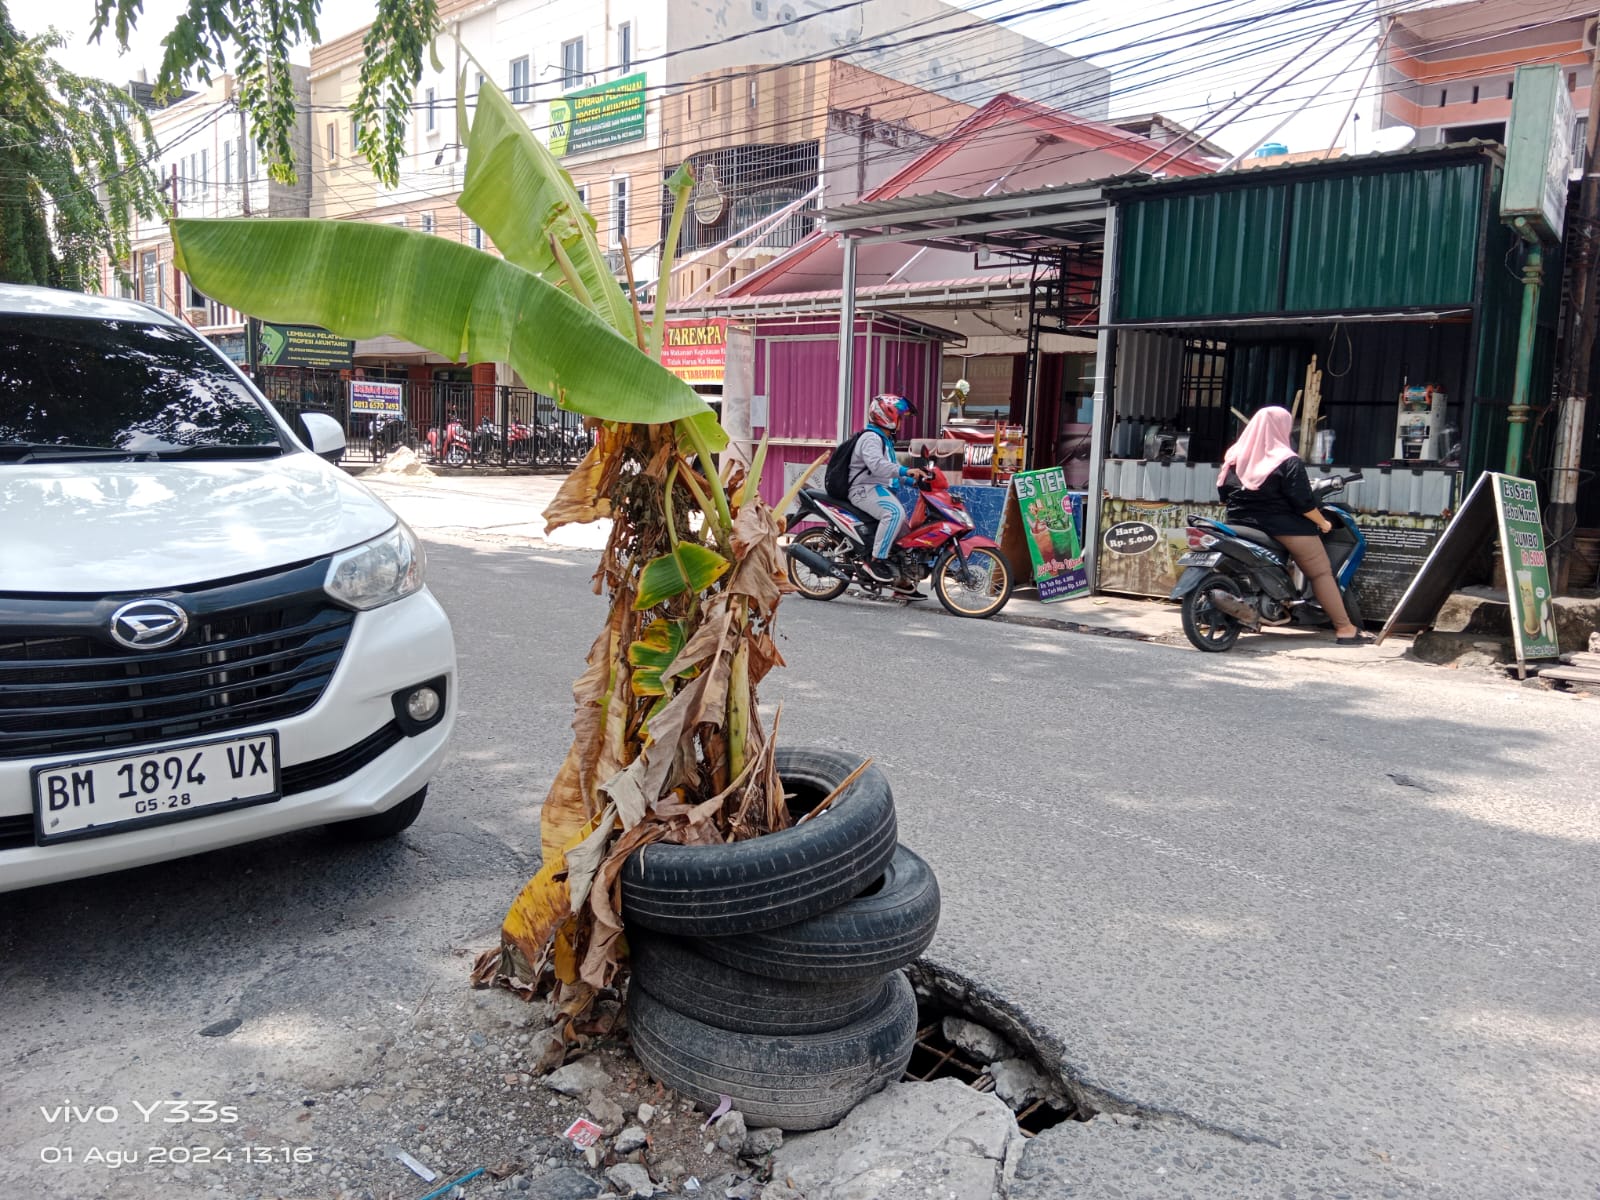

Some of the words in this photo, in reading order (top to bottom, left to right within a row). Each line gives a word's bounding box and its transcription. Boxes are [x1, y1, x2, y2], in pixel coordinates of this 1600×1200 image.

[575, 95, 605, 109] LEMBAGA
[605, 81, 642, 100] PELATIHAN
[575, 107, 601, 125] PROFESI
[601, 97, 641, 117] AKUNTANSI
[286, 330, 317, 338] LEMBAGA
[289, 337, 314, 345] PROFESI
[314, 339, 348, 347] AKUNTANSI
[667, 325, 722, 346] TAREMPA
[353, 401, 369, 409] 0813
[1014, 477, 1036, 499] ES
[1036, 470, 1067, 495] TEH
[1503, 480, 1515, 498] Es
[1514, 483, 1534, 502] Sari
[1503, 502, 1519, 519] Tebu
[1518, 505, 1540, 523] Murni
[1115, 526, 1145, 536] Harga
[1514, 531, 1539, 549] JUMBO
[1109, 539, 1126, 548] Rp.
[1128, 535, 1154, 545] 5.000
[1529, 550, 1545, 567] 5000
[48, 770, 95, 811] BM
[117, 752, 206, 799] 1894
[226, 741, 268, 778] VX
